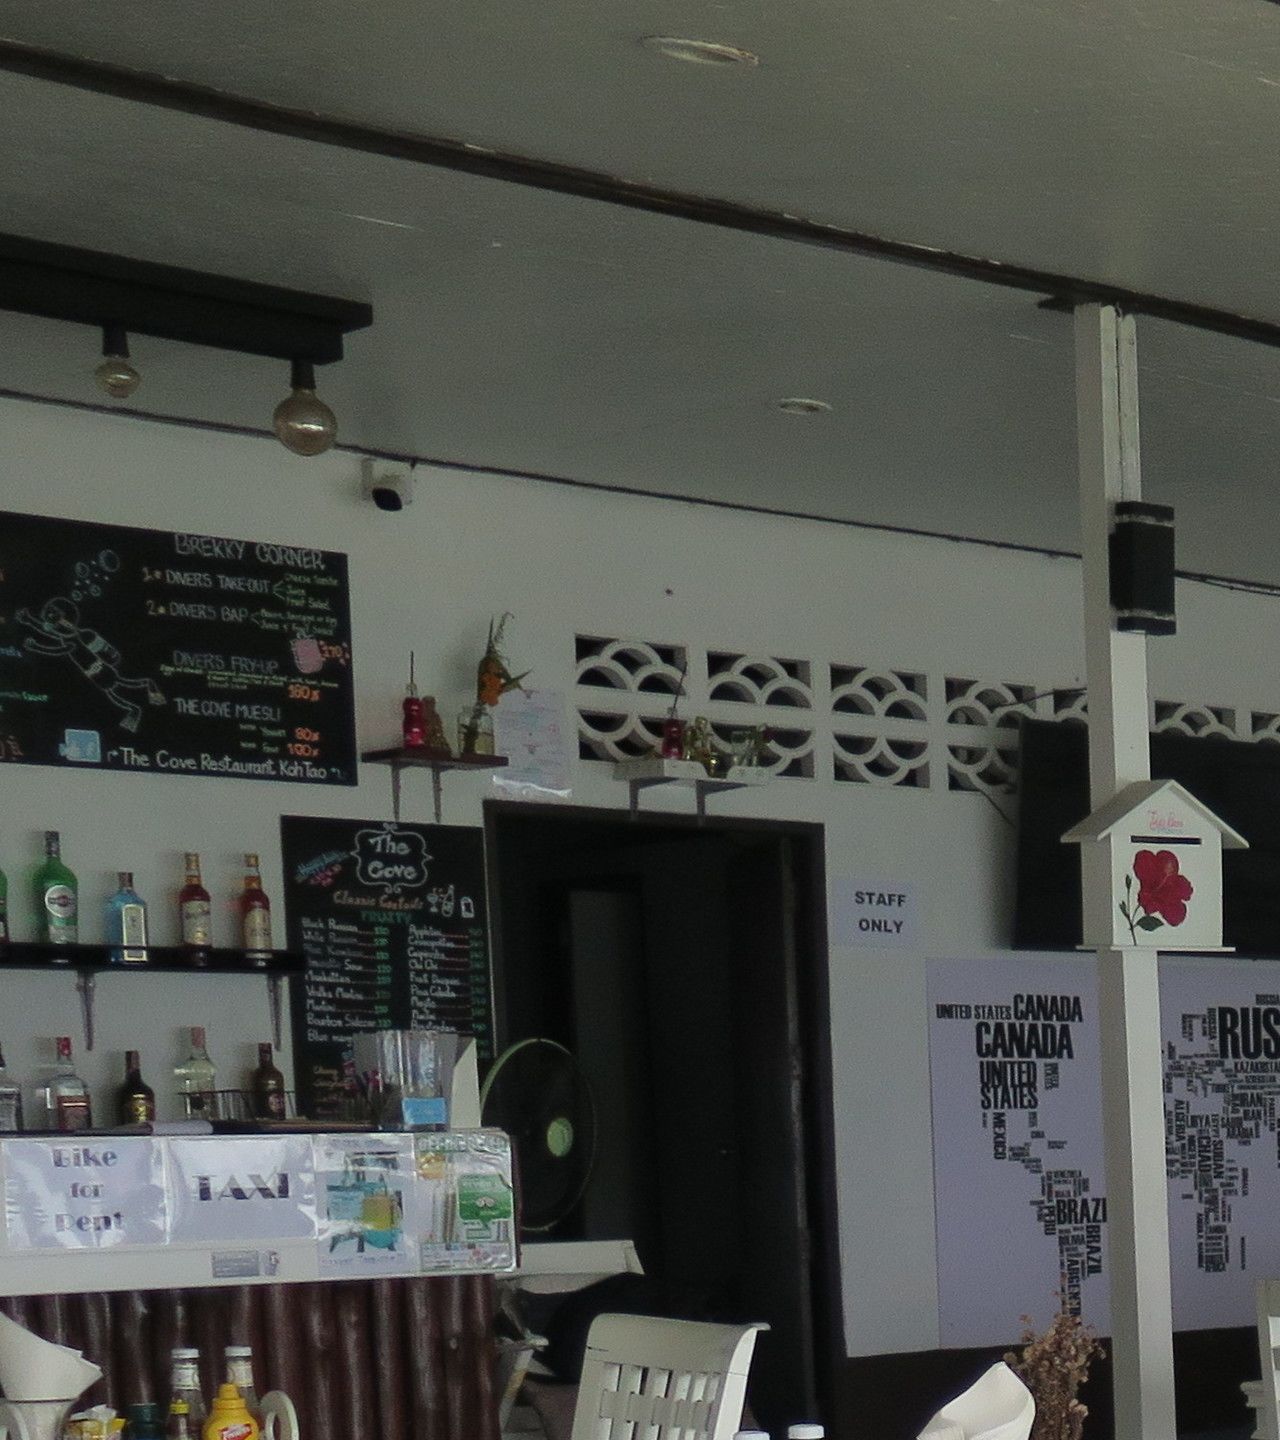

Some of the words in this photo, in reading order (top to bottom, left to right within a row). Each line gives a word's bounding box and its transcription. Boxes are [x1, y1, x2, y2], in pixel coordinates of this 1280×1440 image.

[174, 533, 245, 560] BREKKY
[256, 544, 325, 570] CORNER
[231, 655, 279, 674] FRY-UP
[174, 698, 199, 716] THE
[201, 699, 231, 718] COVE
[235, 704, 281, 722] MUESLI
[120, 746, 150, 768] The
[156, 750, 198, 769] Cove
[200, 753, 276, 776] Restaurant
[368, 833, 411, 856] The
[368, 860, 417, 880] Cove
[855, 891, 906, 907] STAFF
[859, 918, 904, 934] ONLY
[936, 1004, 972, 1020] UNITED
[974, 1004, 1012, 1021] STATES
[1013, 994, 1084, 1023] CANADA
[975, 1021, 1074, 1060] CANADA
[979, 1060, 1038, 1088] UNITED
[980, 1083, 1039, 1110] STATES
[993, 1111, 1007, 1160] MEXICO
[71, 1182, 104, 1198] for
[192, 1171, 290, 1201] TAXI
[55, 1211, 124, 1232] Rent
[1044, 1205, 1057, 1236] PERU
[1056, 1197, 1108, 1225] BRAZI
[1086, 1225, 1102, 1277] BRAZIL
